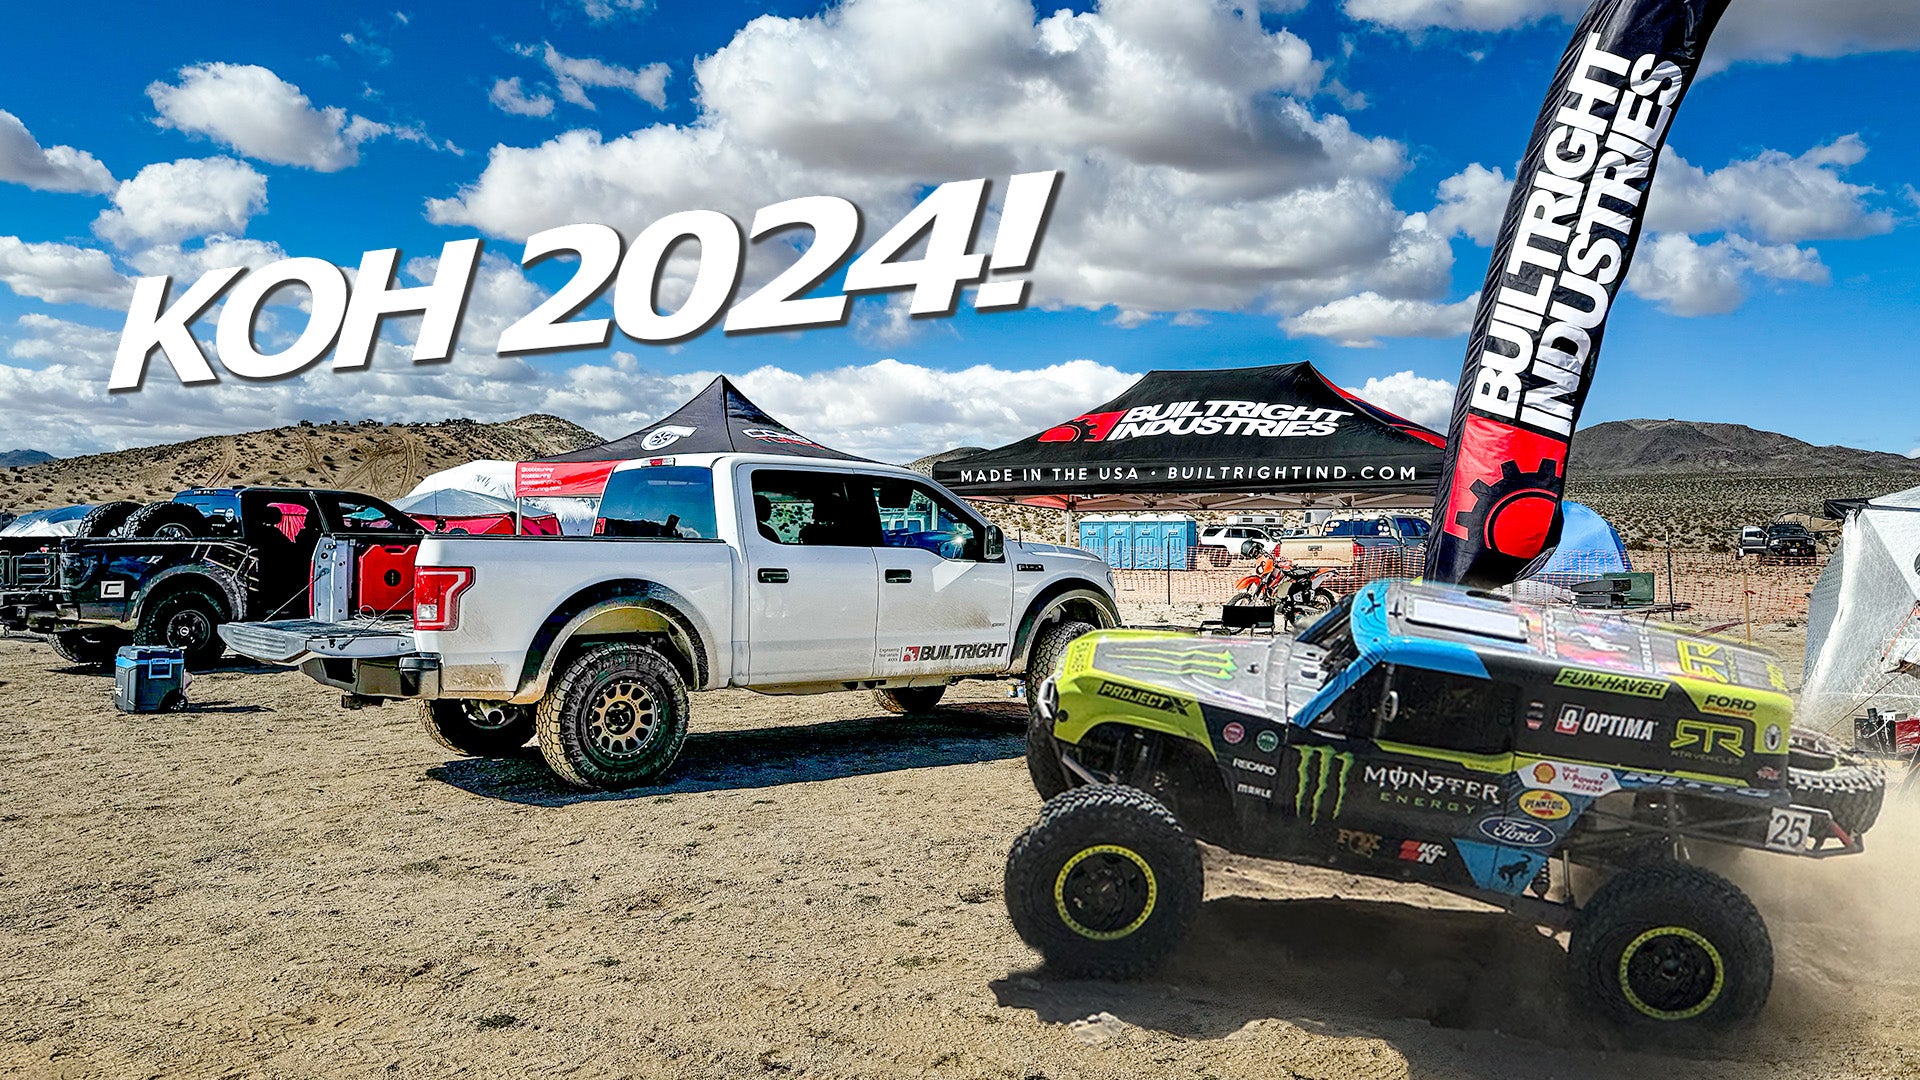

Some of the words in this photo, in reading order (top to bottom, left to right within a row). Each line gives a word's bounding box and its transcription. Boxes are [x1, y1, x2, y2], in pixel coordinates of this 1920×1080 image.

[1470, 32, 1631, 419] BUILTRIGHT
[1519, 53, 1682, 437] INDUSTRIES
[1120, 400, 1354, 423] BUILTRIGHT
[1107, 416, 1339, 440] INDUSTRIES
[960, 468, 1013, 483] MADE
[1023, 468, 1041, 482] IN
[1052, 467, 1088, 481] THE
[1099, 466, 1139, 481] USA
[1167, 465, 1417, 481] BUILTRIGHTIND.COM
[919, 643, 1007, 661] BUILTRIGHT
[1559, 670, 1666, 696] FUN-HAVER
[1101, 683, 1167, 708] PROJECT
[1705, 695, 1756, 710] FORD
[1583, 712, 1654, 741] OPTIMA
[1233, 758, 1277, 776] RECARO
[1363, 765, 1500, 805] MONSTER
[1380, 792, 1475, 814] ENERGY
[1493, 821, 1542, 843] Ford
[1769, 815, 1806, 847] 25
